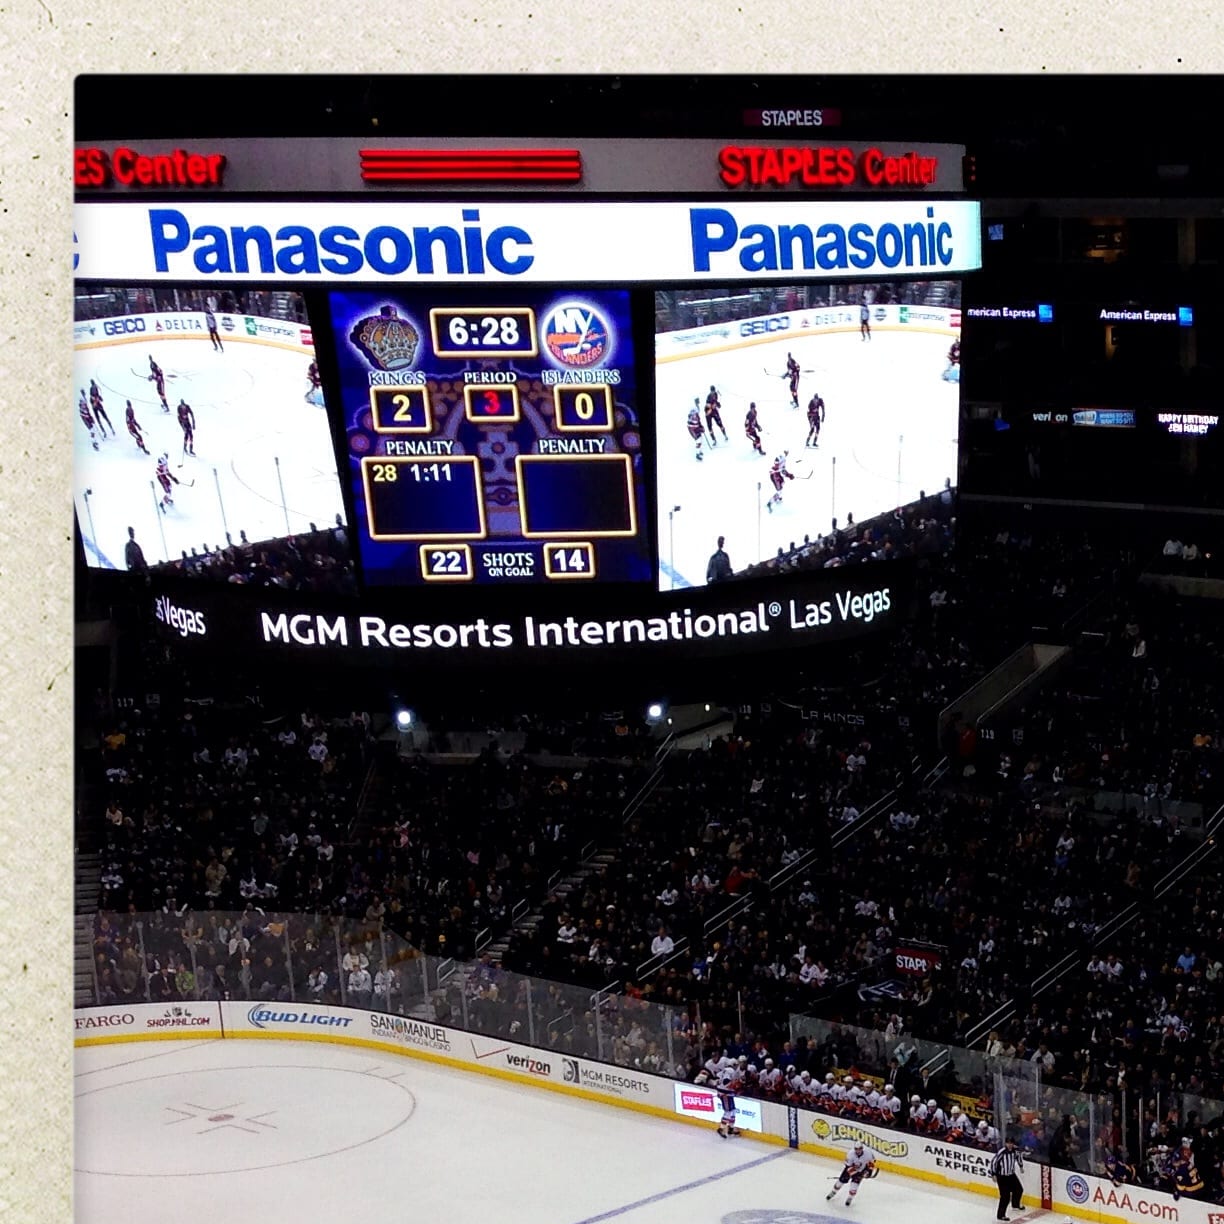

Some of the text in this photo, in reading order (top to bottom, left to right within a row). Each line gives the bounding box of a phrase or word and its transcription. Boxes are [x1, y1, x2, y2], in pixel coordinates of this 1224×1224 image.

[761, 110, 823, 126] STAPLES
[113, 147, 227, 185] Center
[719, 145, 938, 188] STAPLES Center
[149, 208, 535, 276] Panasonic
[690, 205, 954, 273] Panasonic
[740, 315, 790, 337] GEICO
[815, 313, 852, 326] DELTA
[1002, 308, 1036, 320] Express
[1100, 309, 1176, 322] American Express
[103, 317, 146, 336] GEICO
[166, 318, 202, 330] DELTA
[450, 317, 520, 345] 6:28
[368, 370, 621, 386] KINGS PERIOD ISLANDERS
[392, 391, 594, 422] 2 3 0
[1033, 411, 1068, 423] verion
[386, 439, 605, 456] PENALTY PENALTY
[372, 463, 452, 482] 28 1:11
[432, 549, 585, 573] 22 SHOTS 14
[488, 567, 534, 577] ON GOAL
[162, 594, 207, 638] Vegas
[261, 612, 347, 647] MGM
[360, 617, 513, 648] Resorts
[789, 599, 832, 630] Las
[835, 587, 891, 623] Vegas
[801, 709, 865, 726] LA KINGS
[75, 1013, 135, 1030] FARGO
[256, 1009, 352, 1028] BUD LIGHT
[370, 1014, 394, 1030] SAN
[403, 1021, 450, 1044] MANUEL
[506, 1053, 551, 1076] verizon
[581, 1068, 650, 1093] MGM RESORTS
[682, 1095, 712, 1107] STAPLES
[924, 1145, 992, 1167] AMERICAN
[936, 1157, 993, 1178] EXPRESS
[1093, 1186, 1178, 1222] AAA.com
